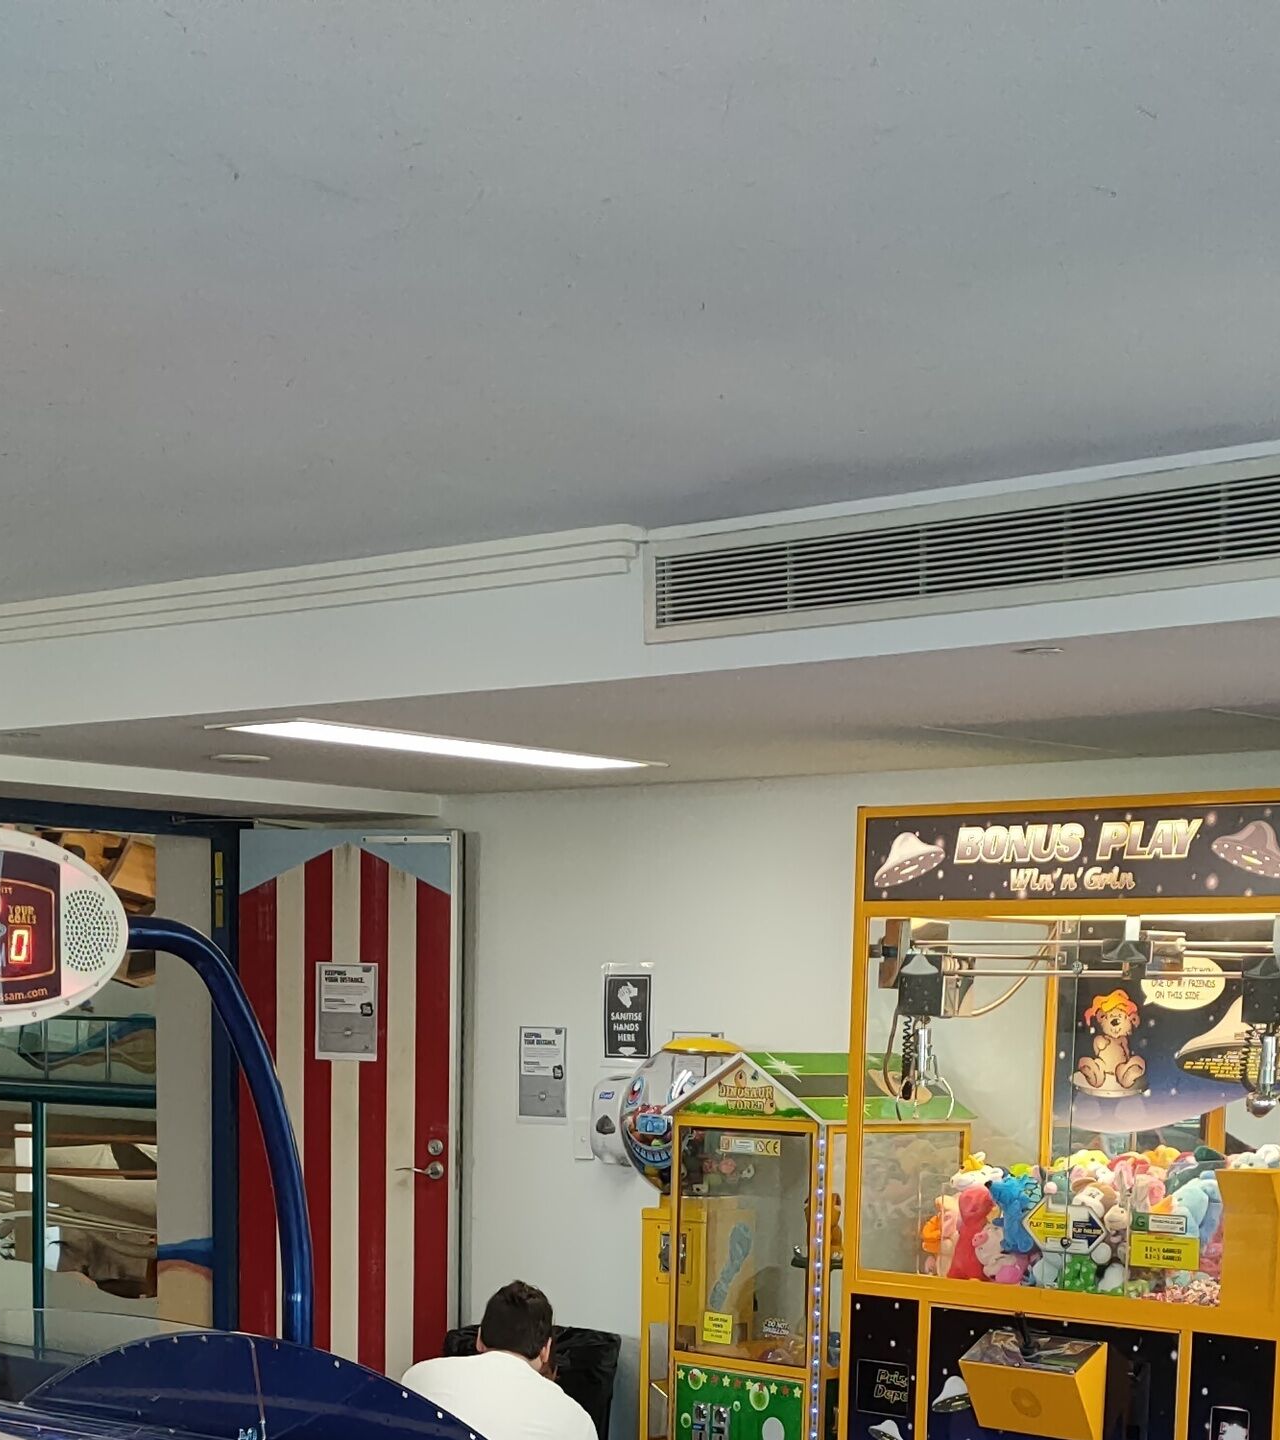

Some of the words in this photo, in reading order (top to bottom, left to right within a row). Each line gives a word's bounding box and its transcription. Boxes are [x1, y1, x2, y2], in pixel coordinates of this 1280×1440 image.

[954, 822, 1086, 865] BONUS
[1096, 818, 1204, 861] PLAY
[10, 929, 29, 962] 0
[610, 1011, 643, 1021] SANITISE
[613, 1022, 640, 1032] HANDS
[617, 1033, 636, 1042] HERE
[718, 1084, 774, 1100] DINOSAUR
[726, 1099, 765, 1111] WORLD
[1135, 1215, 1146, 1228] G
[873, 1384, 908, 1404] Depo
